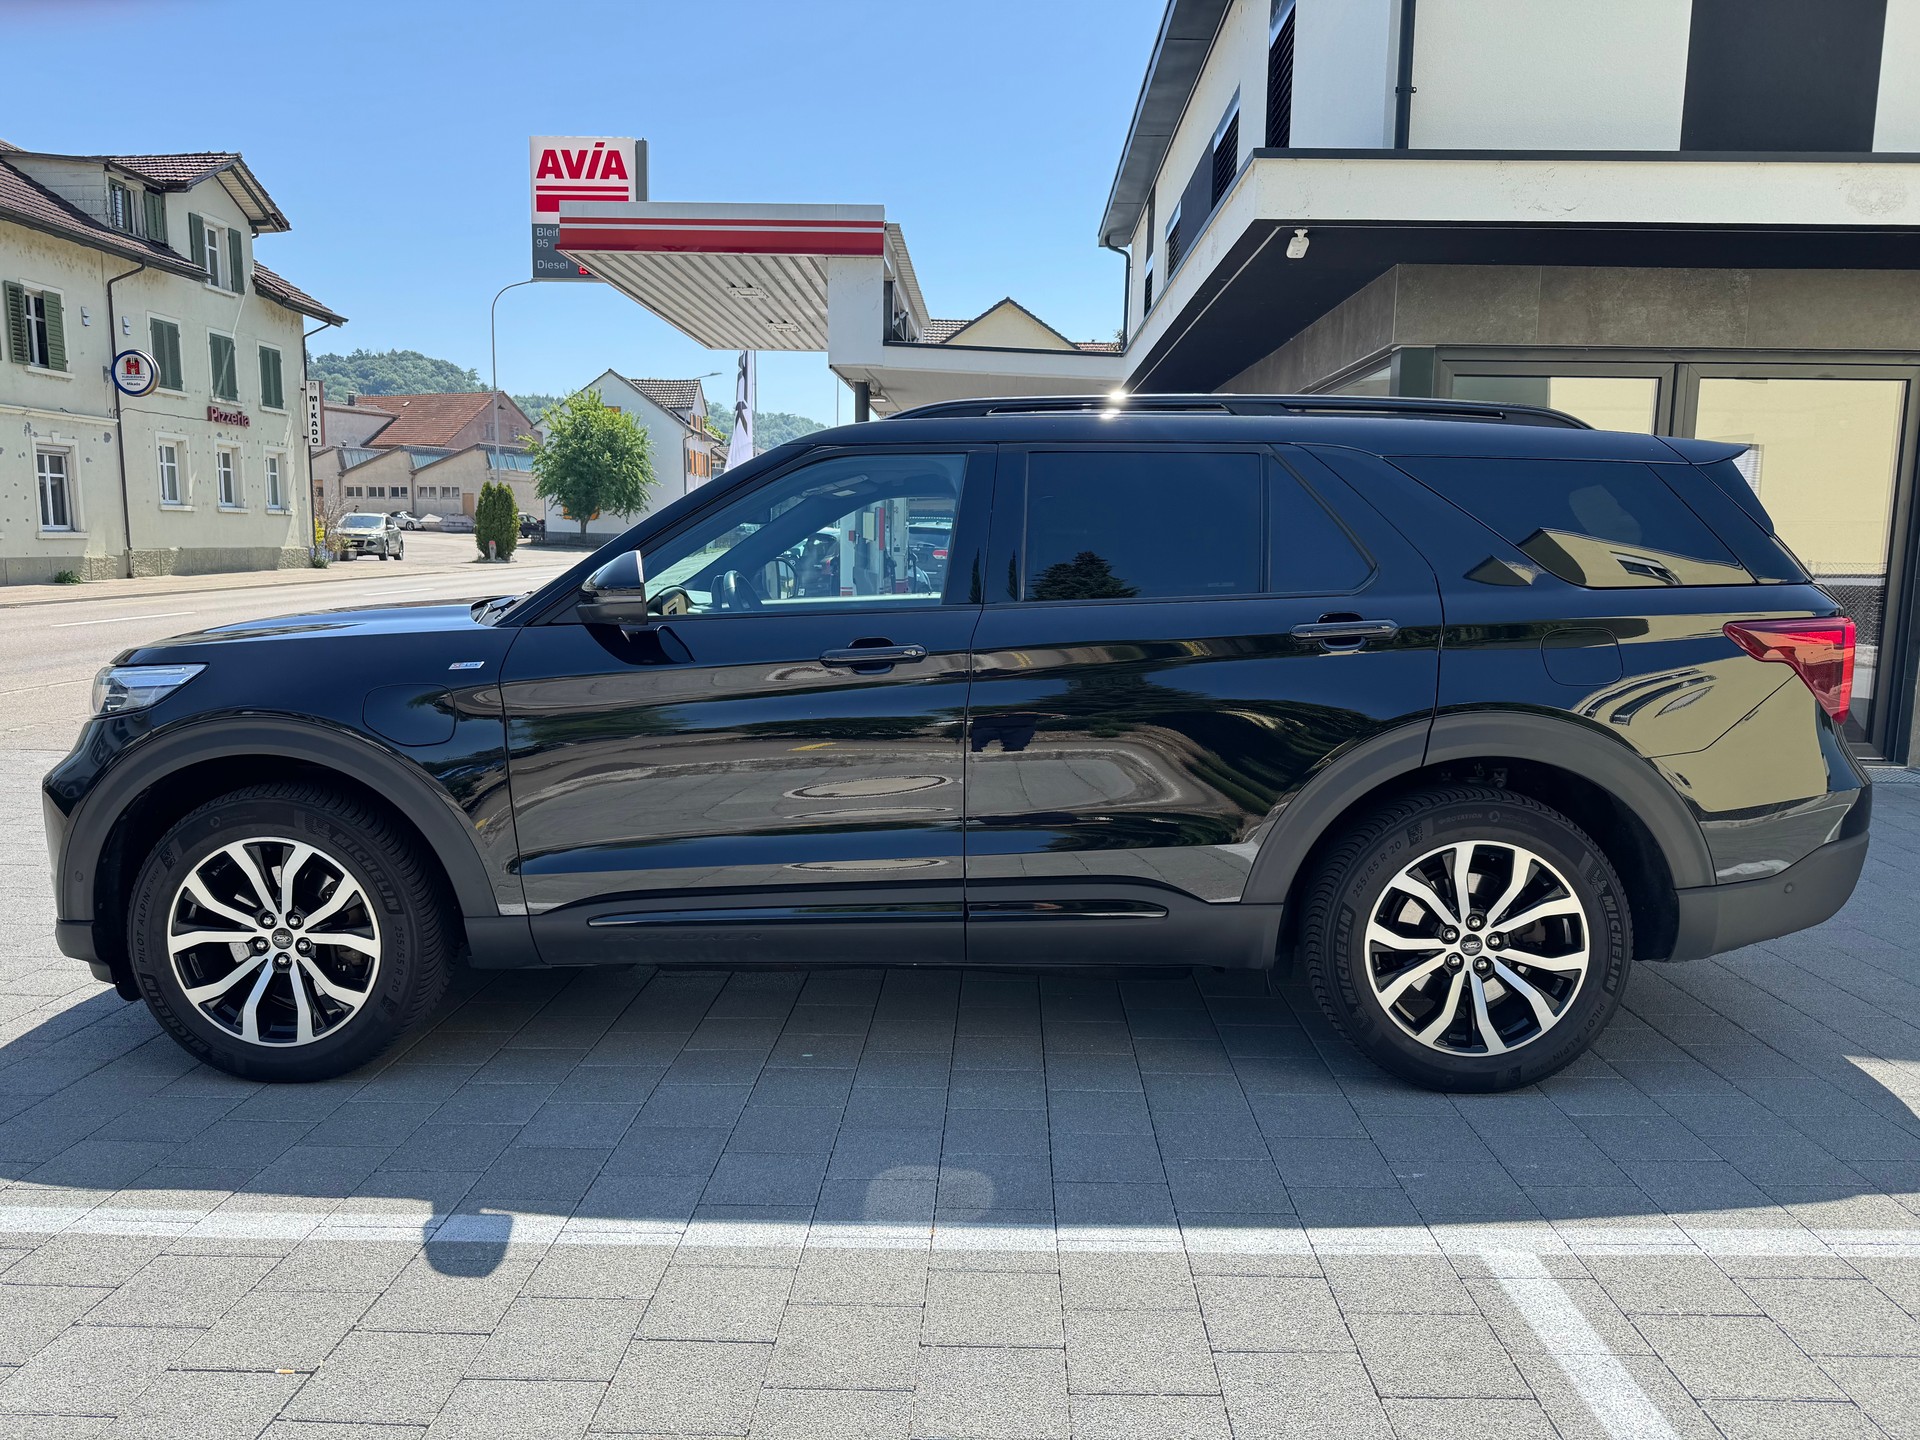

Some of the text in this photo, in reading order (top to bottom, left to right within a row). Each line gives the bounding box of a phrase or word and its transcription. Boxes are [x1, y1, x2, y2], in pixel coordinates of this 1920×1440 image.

[536, 239, 549, 248] 95
[537, 260, 569, 270] Diesel
[211, 407, 251, 428] Pizzeria
[309, 395, 319, 444] MIKADO
[332, 832, 400, 912] MICHELIN
[1352, 861, 1381, 899] 255/55
[1388, 840, 1402, 856] 20
[140, 891, 151, 926] ALPIN
[136, 930, 147, 963] PILOT
[602, 932, 762, 942] EXPLORER
[1603, 895, 1622, 991] MICHELIN
[392, 926, 405, 993] 255/55 R 20
[1336, 908, 1360, 1005] MICHELIN
[143, 977, 210, 1053] MICHELIN
[1584, 1002, 1606, 1034] PILOT
[1552, 1034, 1581, 1062] ALPIN
